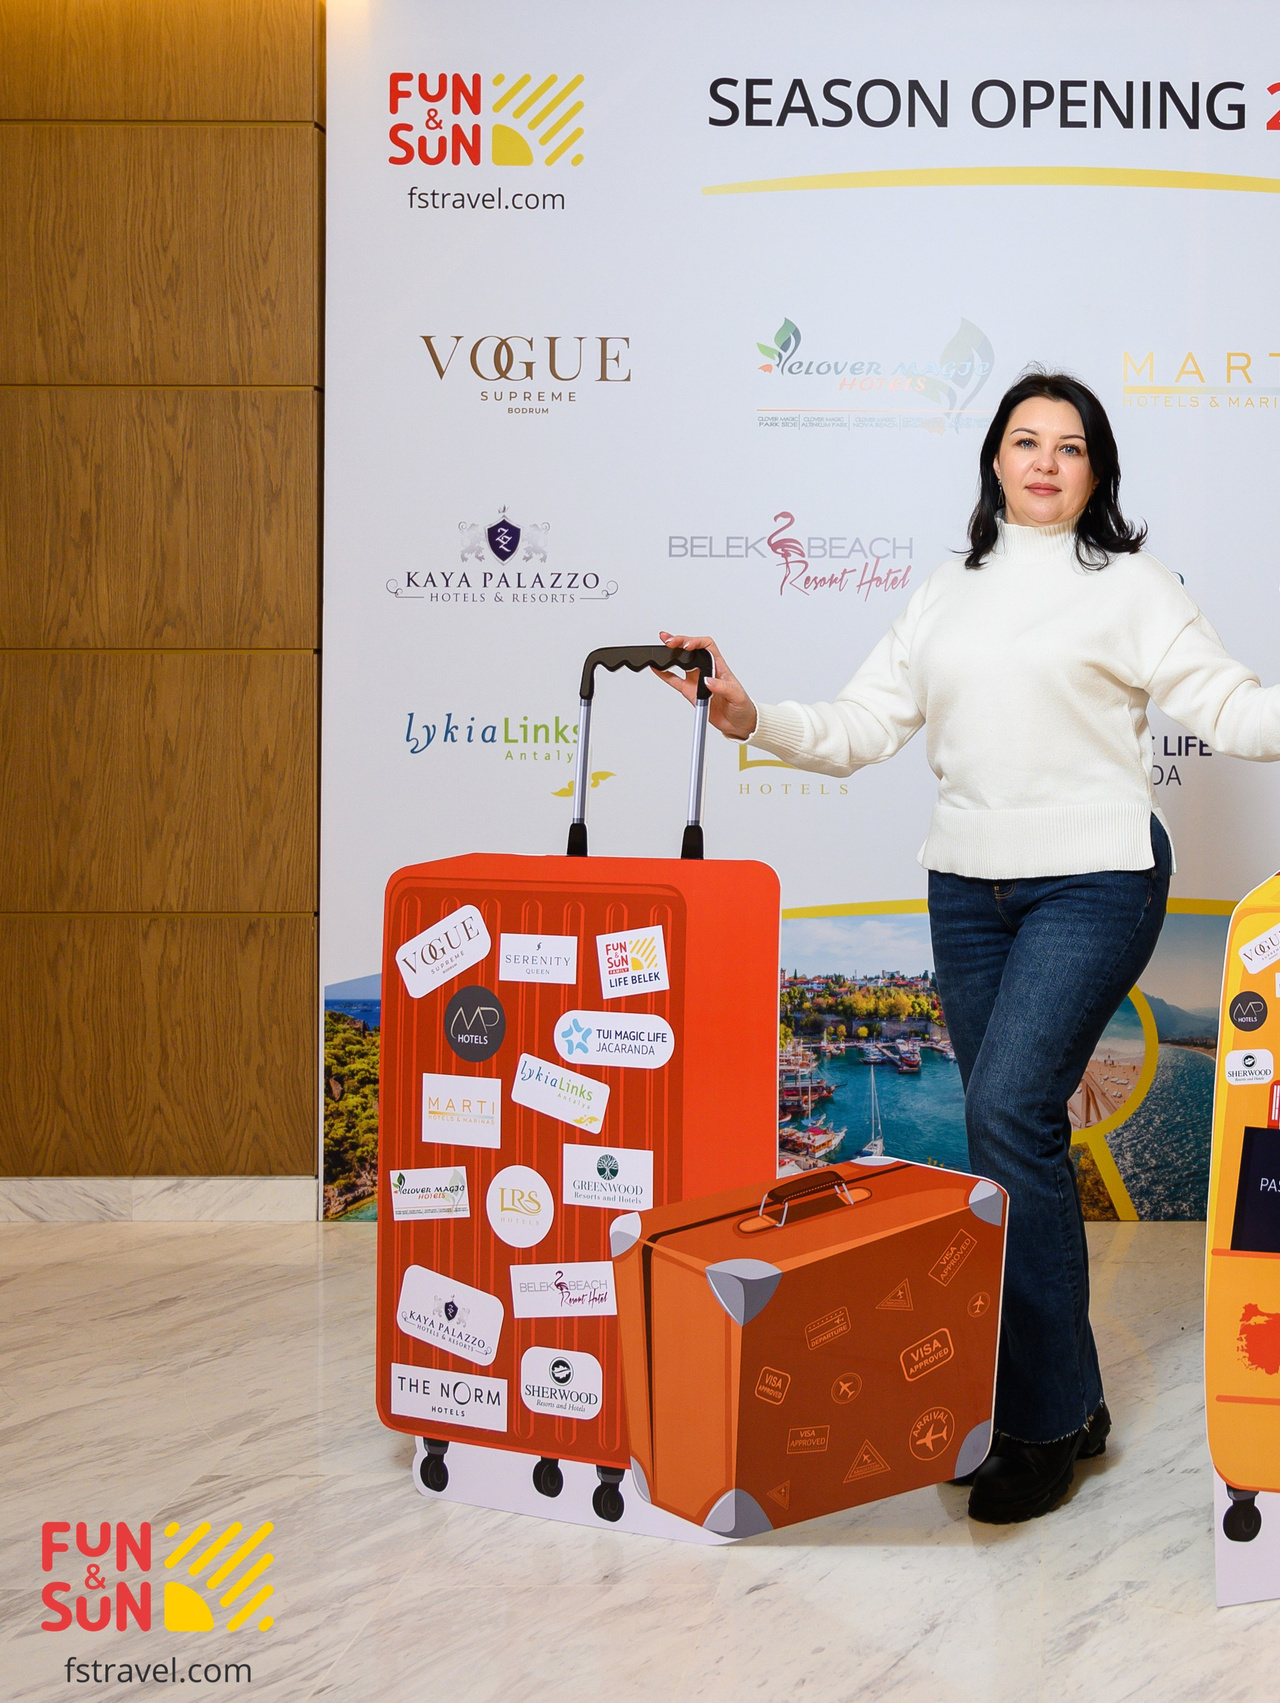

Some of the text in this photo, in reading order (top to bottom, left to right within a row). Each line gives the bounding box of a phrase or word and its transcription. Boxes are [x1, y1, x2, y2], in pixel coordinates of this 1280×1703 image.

[388, 72, 481, 116] FUN
[708, 78, 948, 128] SEASON
[971, 80, 1245, 129] OPENING
[424, 108, 443, 130] &
[388, 123, 481, 166] SUN
[407, 187, 566, 211] fstravel.com
[419, 335, 631, 383] VOGUE
[788, 361, 990, 376] CLOVER MAGIC
[481, 391, 576, 401] SUPREME
[1122, 395, 1199, 408] HOTELS
[1209, 395, 1220, 408] &
[668, 536, 913, 560] BELEK BEACH
[405, 571, 600, 589] KAYA PALAZZO
[779, 559, 911, 602] Resort Hotel
[430, 592, 575, 603] HOTELS & RESORTS
[1163, 736, 1212, 757] LIFE
[505, 750, 574, 763] Antaly
[739, 783, 849, 794] HOTELS
[402, 916, 480, 974] VOGUE
[605, 941, 627, 955] FUN
[431, 950, 465, 974] SUPREME
[505, 954, 571, 967] SERENITY
[607, 955, 629, 969] SUN
[609, 976, 629, 988] LIFE
[631, 971, 661, 985] BELEK
[457, 1034, 488, 1044] HOTELS
[596, 1029, 667, 1043] TUI MAGIC LIFE
[596, 1042, 655, 1055] JACARANDA
[520, 1060, 593, 1102] lykiaLinks
[1227, 1068, 1272, 1078] SHERWOOD
[428, 1096, 495, 1115] MARTI
[557, 1093, 591, 1110] Antalya
[428, 1114, 454, 1122] HOTELS
[572, 1179, 643, 1196] GREENWOOD
[499, 1187, 542, 1216] LRS
[574, 1191, 642, 1205] Resorts and Hotels
[500, 1217, 540, 1226] HOTELS
[939, 1238, 972, 1280] APPROVED
[940, 1246, 957, 1265] VISA
[519, 1279, 608, 1293] BELEK BEACH
[408, 1310, 486, 1349] KAYA PALAZZO
[416, 1323, 440, 1338] HOTELS
[448, 1337, 474, 1352] RESORTS
[811, 1325, 848, 1348] DEPARTURE
[910, 1339, 942, 1363] VISA
[909, 1347, 949, 1375] APPROVED
[764, 1374, 783, 1388] VISA
[398, 1376, 501, 1406] THE NORM
[524, 1384, 598, 1406] SHERWOOD
[758, 1383, 783, 1399] APPROVED
[431, 1405, 466, 1418] HOTELS
[536, 1399, 586, 1413] Resorts and Hotels
[912, 1411, 949, 1438] ARRIVAL
[790, 1437, 826, 1448] APPROVED
[799, 1430, 816, 1438] VISA
